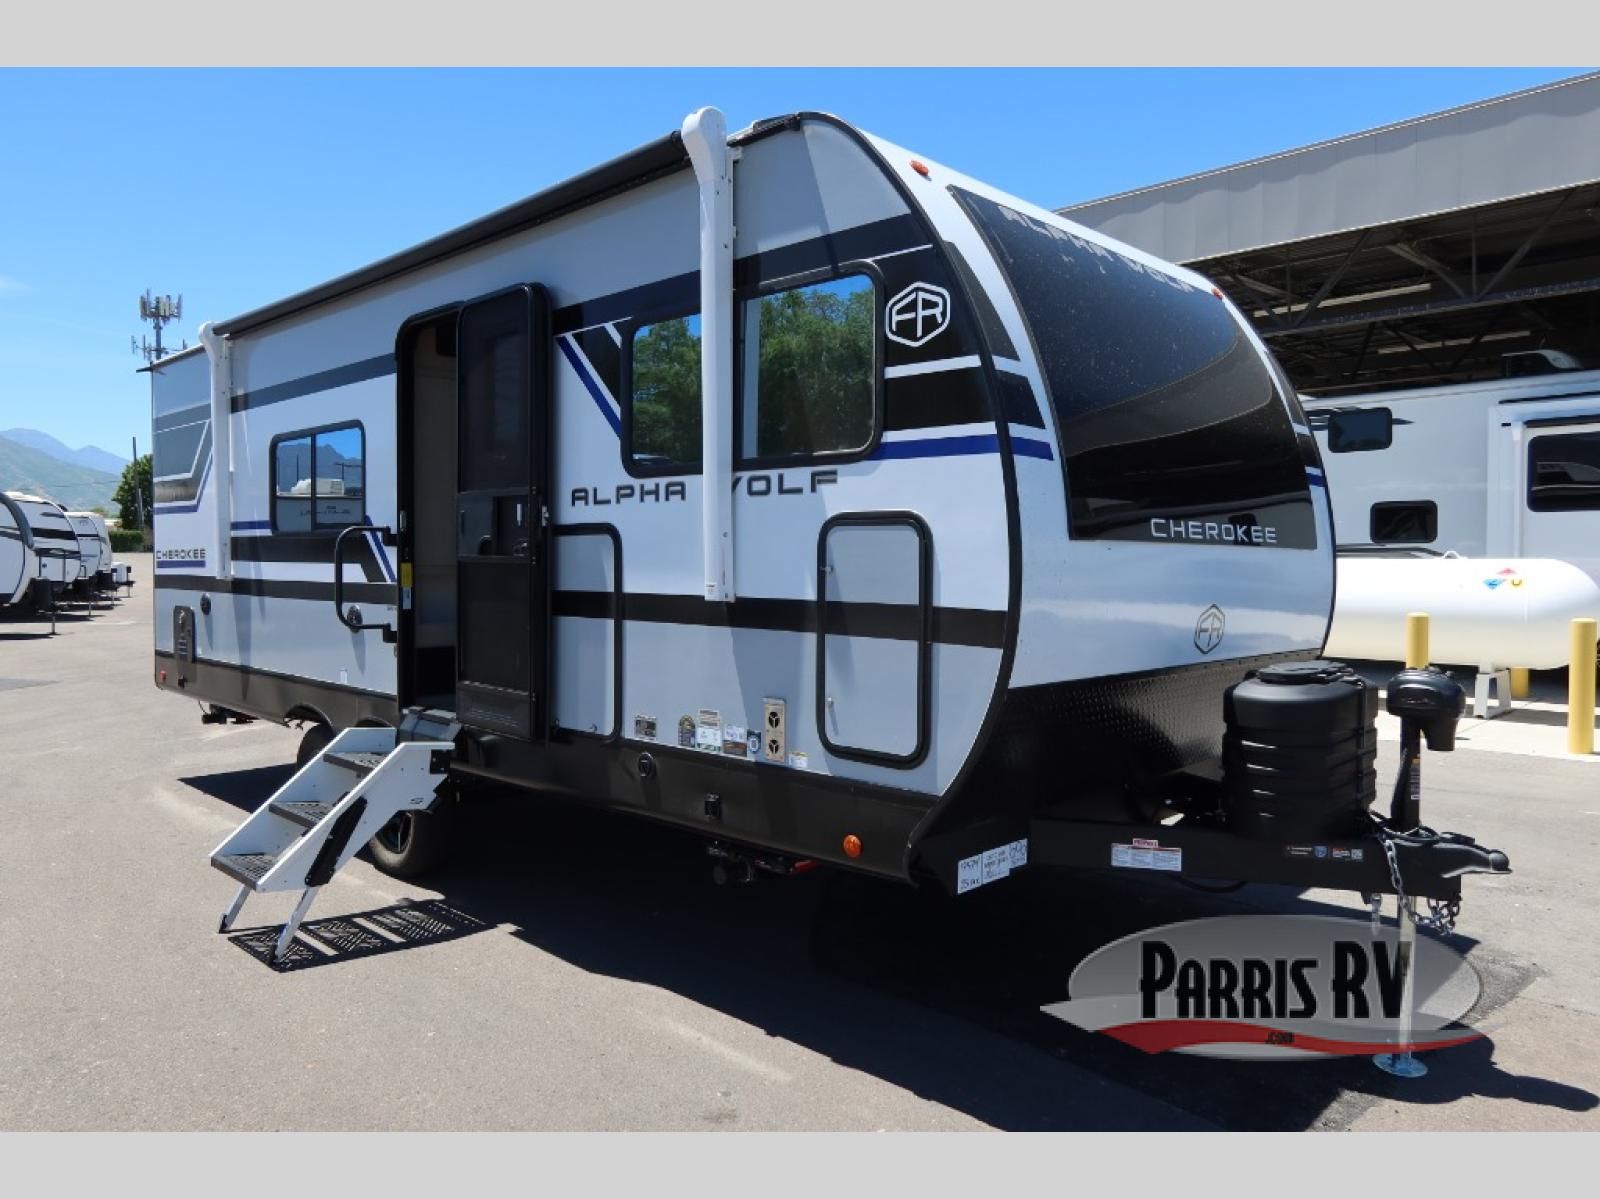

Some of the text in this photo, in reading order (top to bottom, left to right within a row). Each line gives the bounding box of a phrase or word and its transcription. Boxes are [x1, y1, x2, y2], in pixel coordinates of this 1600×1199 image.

[889, 287, 946, 342] FR
[571, 469, 839, 507] ALPHA OLF
[1149, 517, 1278, 545] CHEROKEE
[155, 548, 206, 560] CHEROKEE
